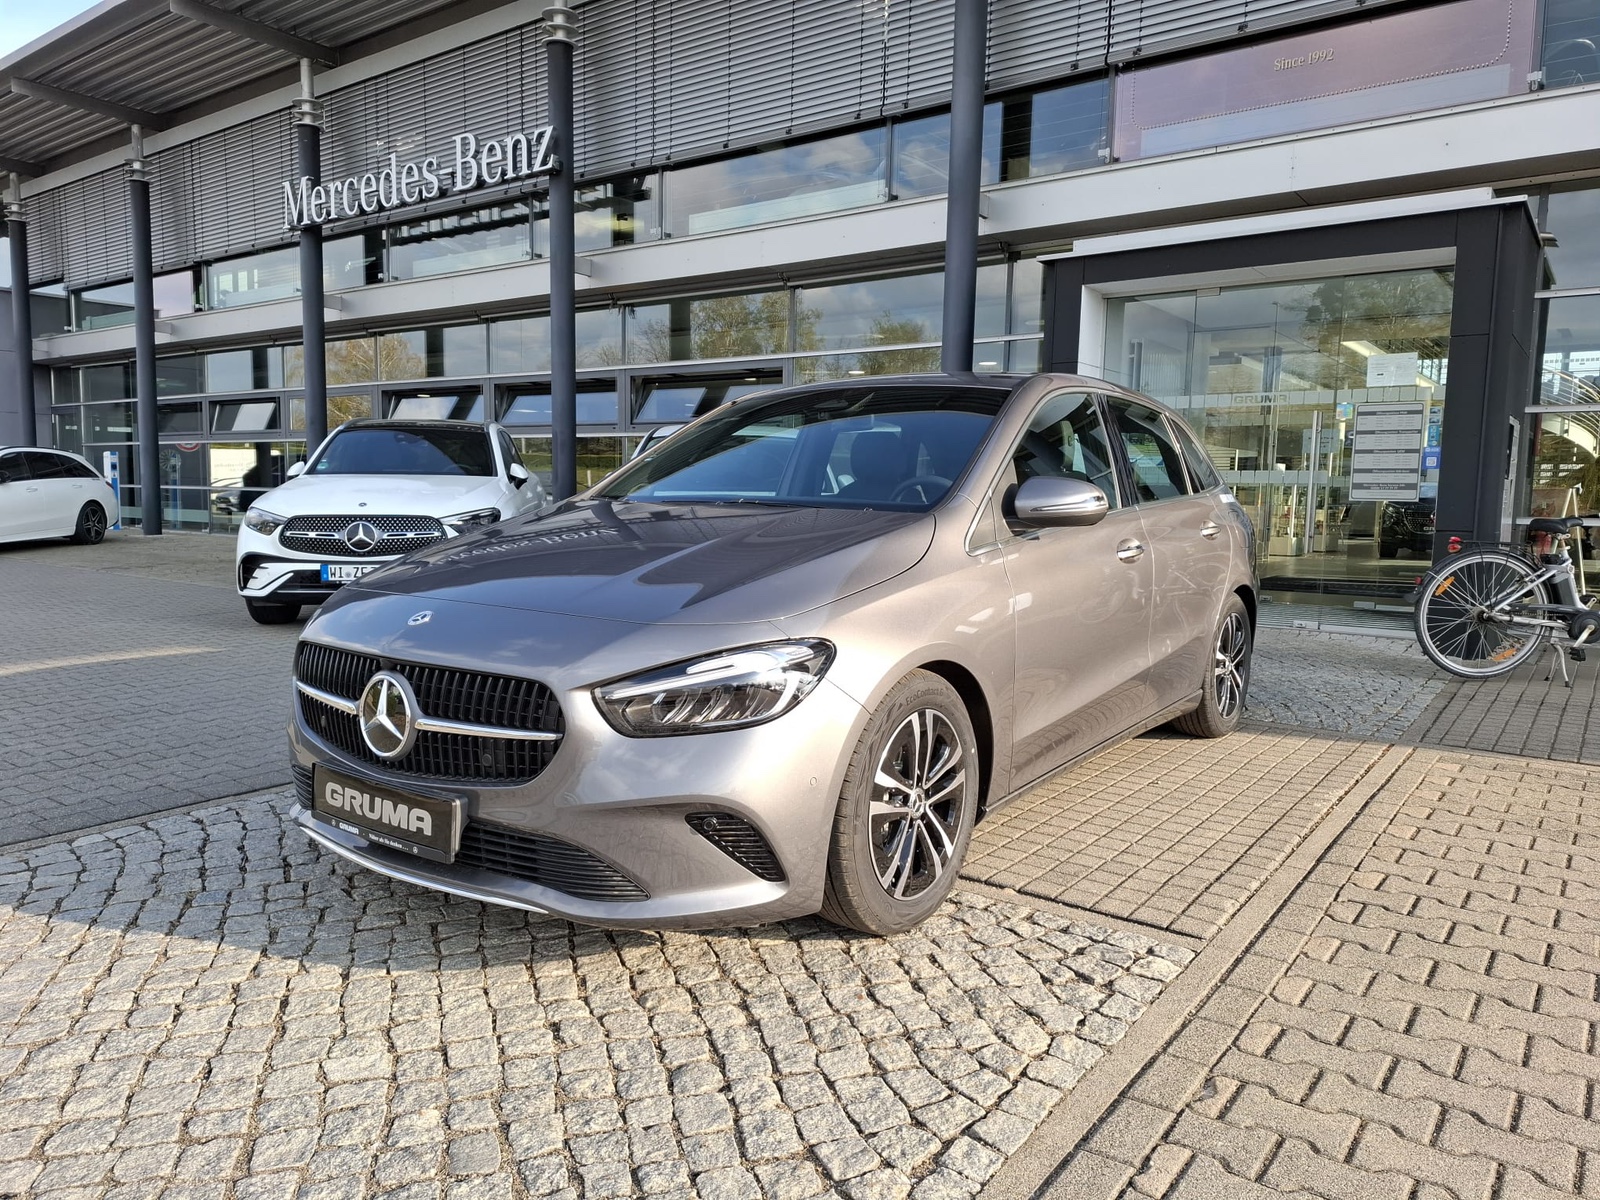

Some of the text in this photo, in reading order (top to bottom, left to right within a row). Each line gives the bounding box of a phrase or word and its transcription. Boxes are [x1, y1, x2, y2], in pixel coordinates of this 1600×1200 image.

[1274, 48, 1335, 72] Since 1992
[282, 125, 557, 230] Mercedes-Benz
[325, 781, 432, 837] GRUMA
[339, 822, 360, 835] GRUMA
